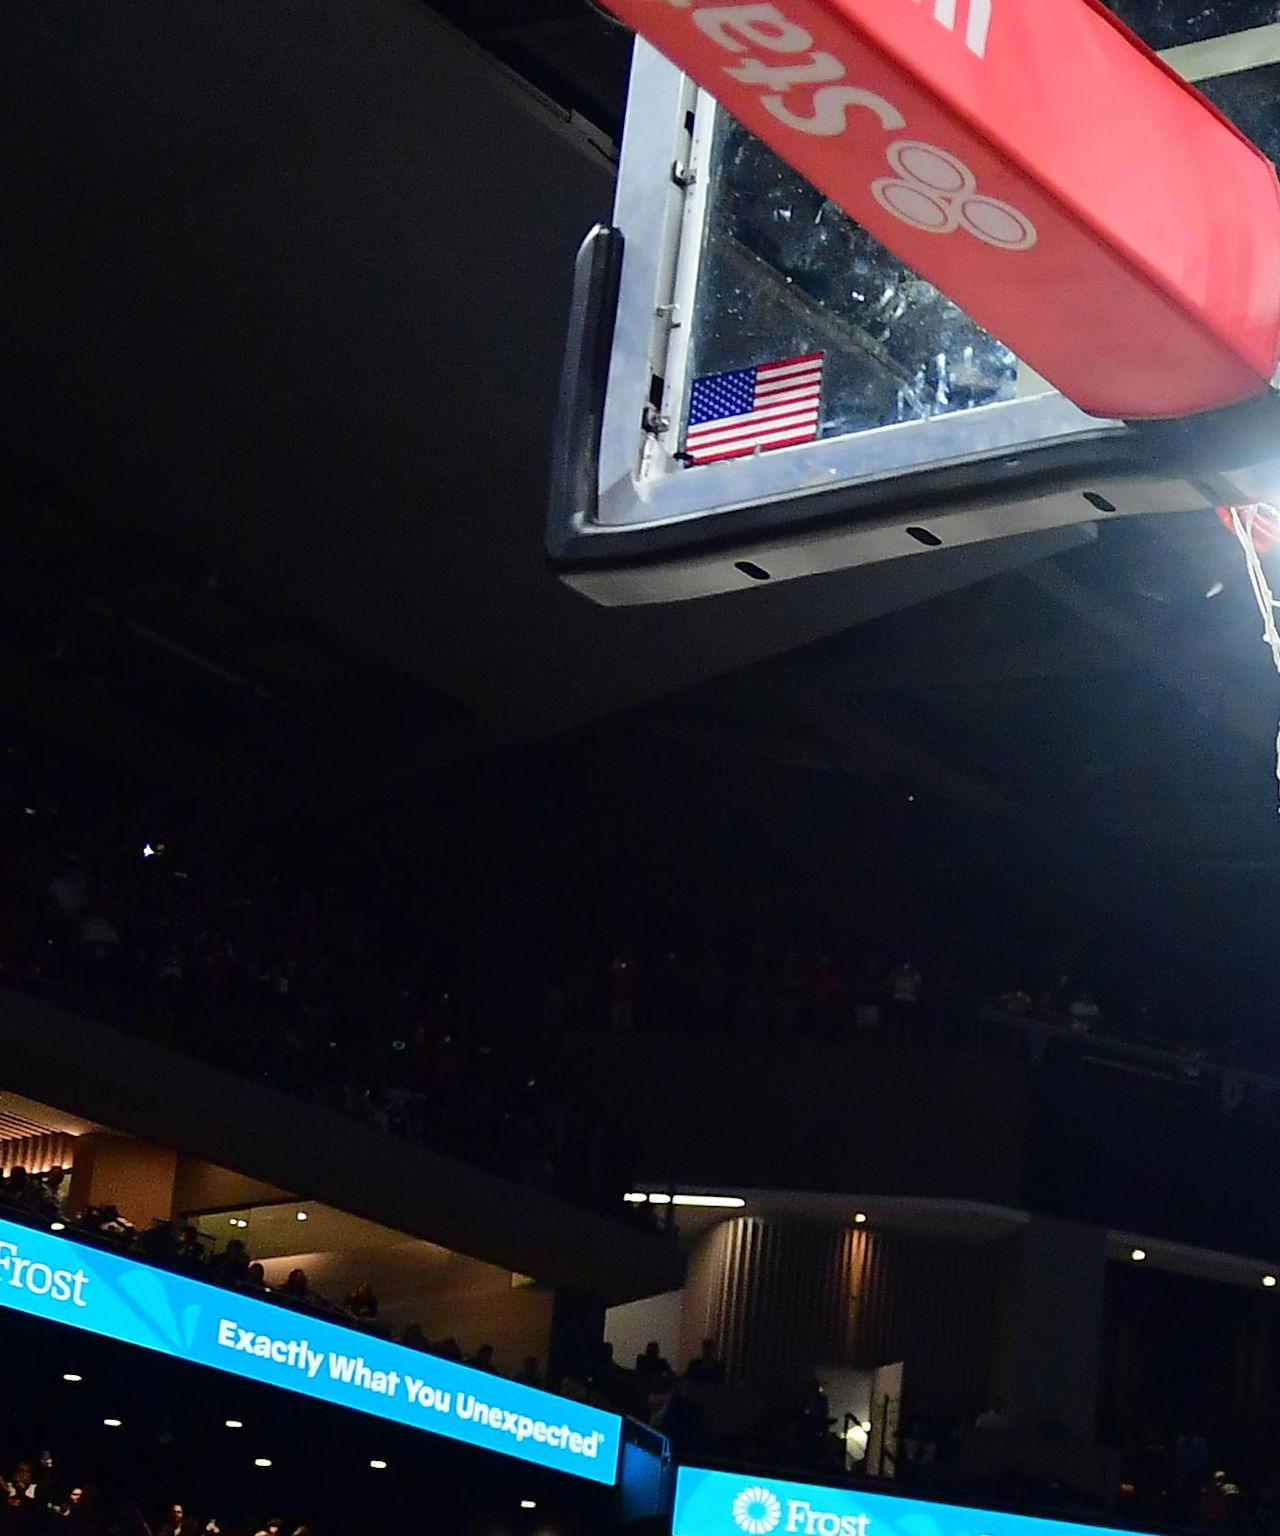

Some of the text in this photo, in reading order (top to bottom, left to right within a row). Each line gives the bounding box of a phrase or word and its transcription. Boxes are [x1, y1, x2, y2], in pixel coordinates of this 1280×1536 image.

[668, 0, 906, 136] Sta
[0, 1240, 89, 1306] Frost
[218, 1320, 324, 1377] Exactly
[329, 1354, 401, 1396] What
[405, 1376, 451, 1413] You
